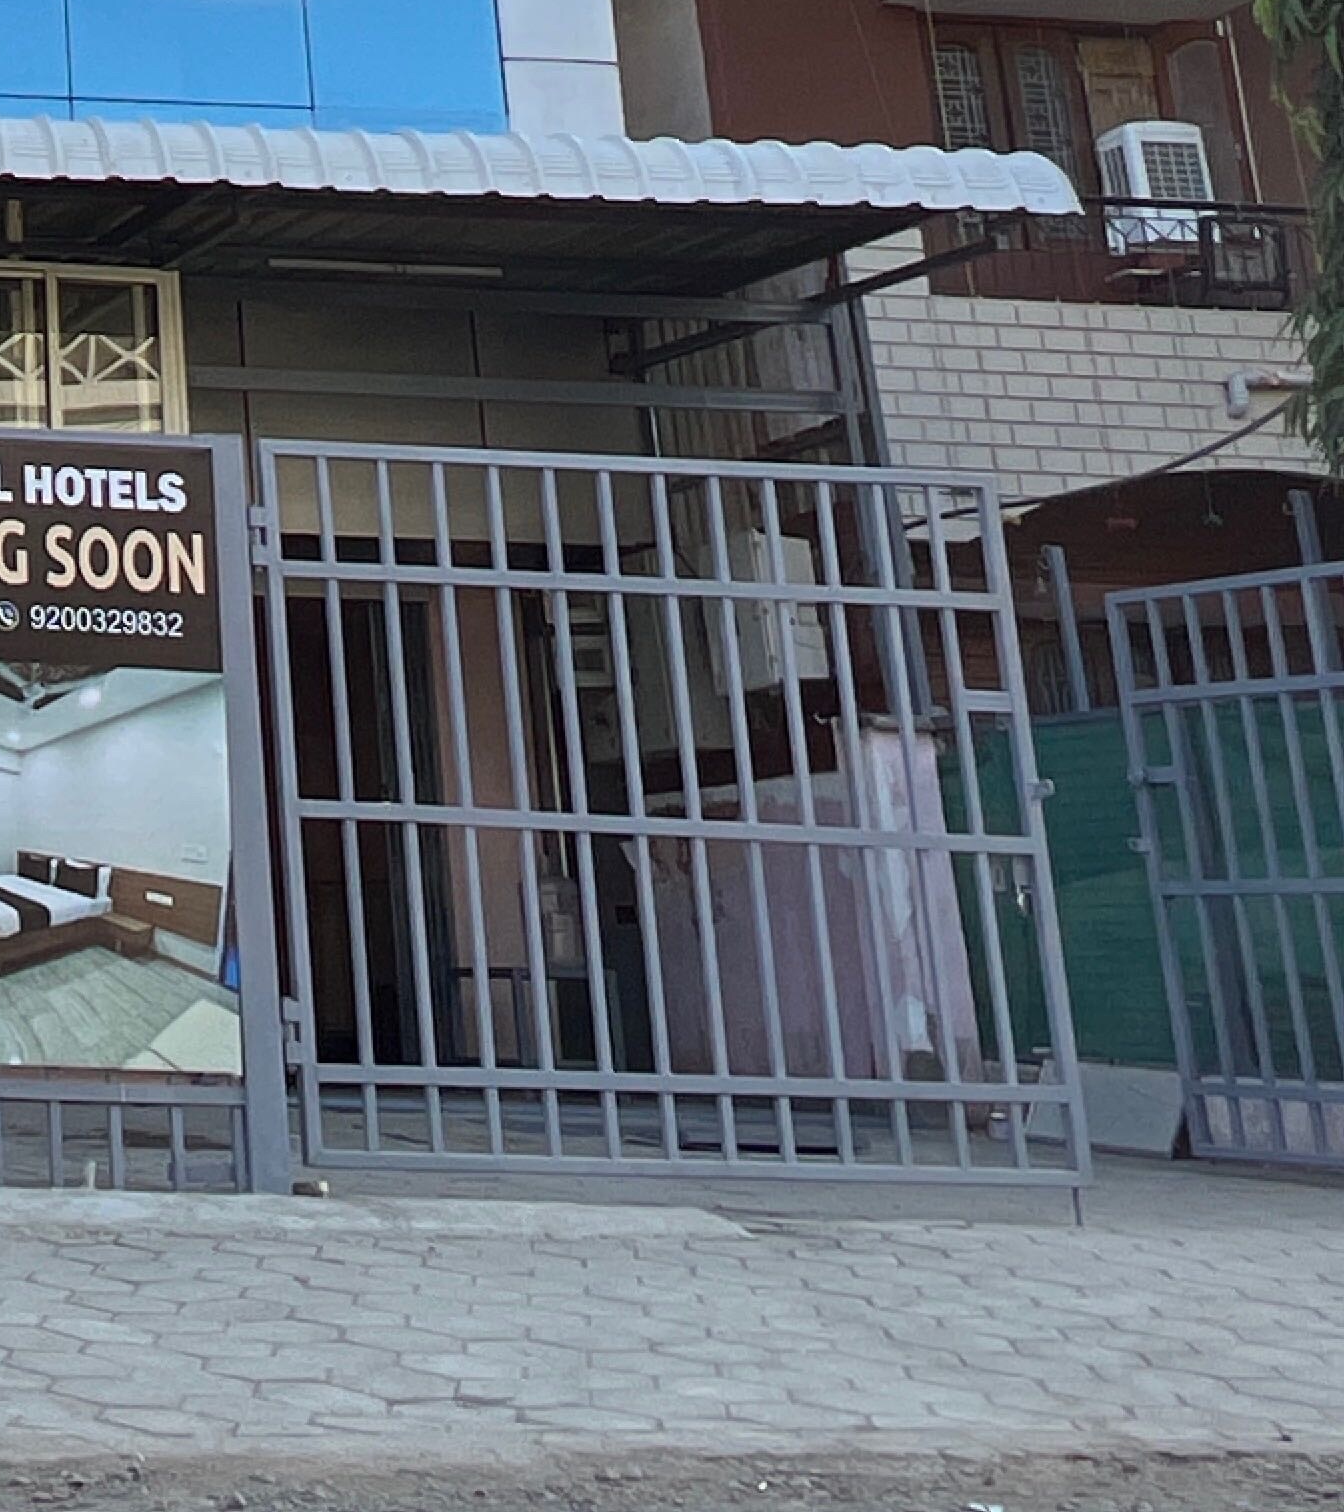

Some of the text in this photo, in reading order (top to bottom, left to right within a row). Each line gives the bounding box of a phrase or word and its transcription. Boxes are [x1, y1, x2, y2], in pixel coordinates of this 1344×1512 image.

[24, 464, 188, 513] HOTELS
[45, 523, 206, 595] SOON
[29, 606, 185, 638] 9200329832
